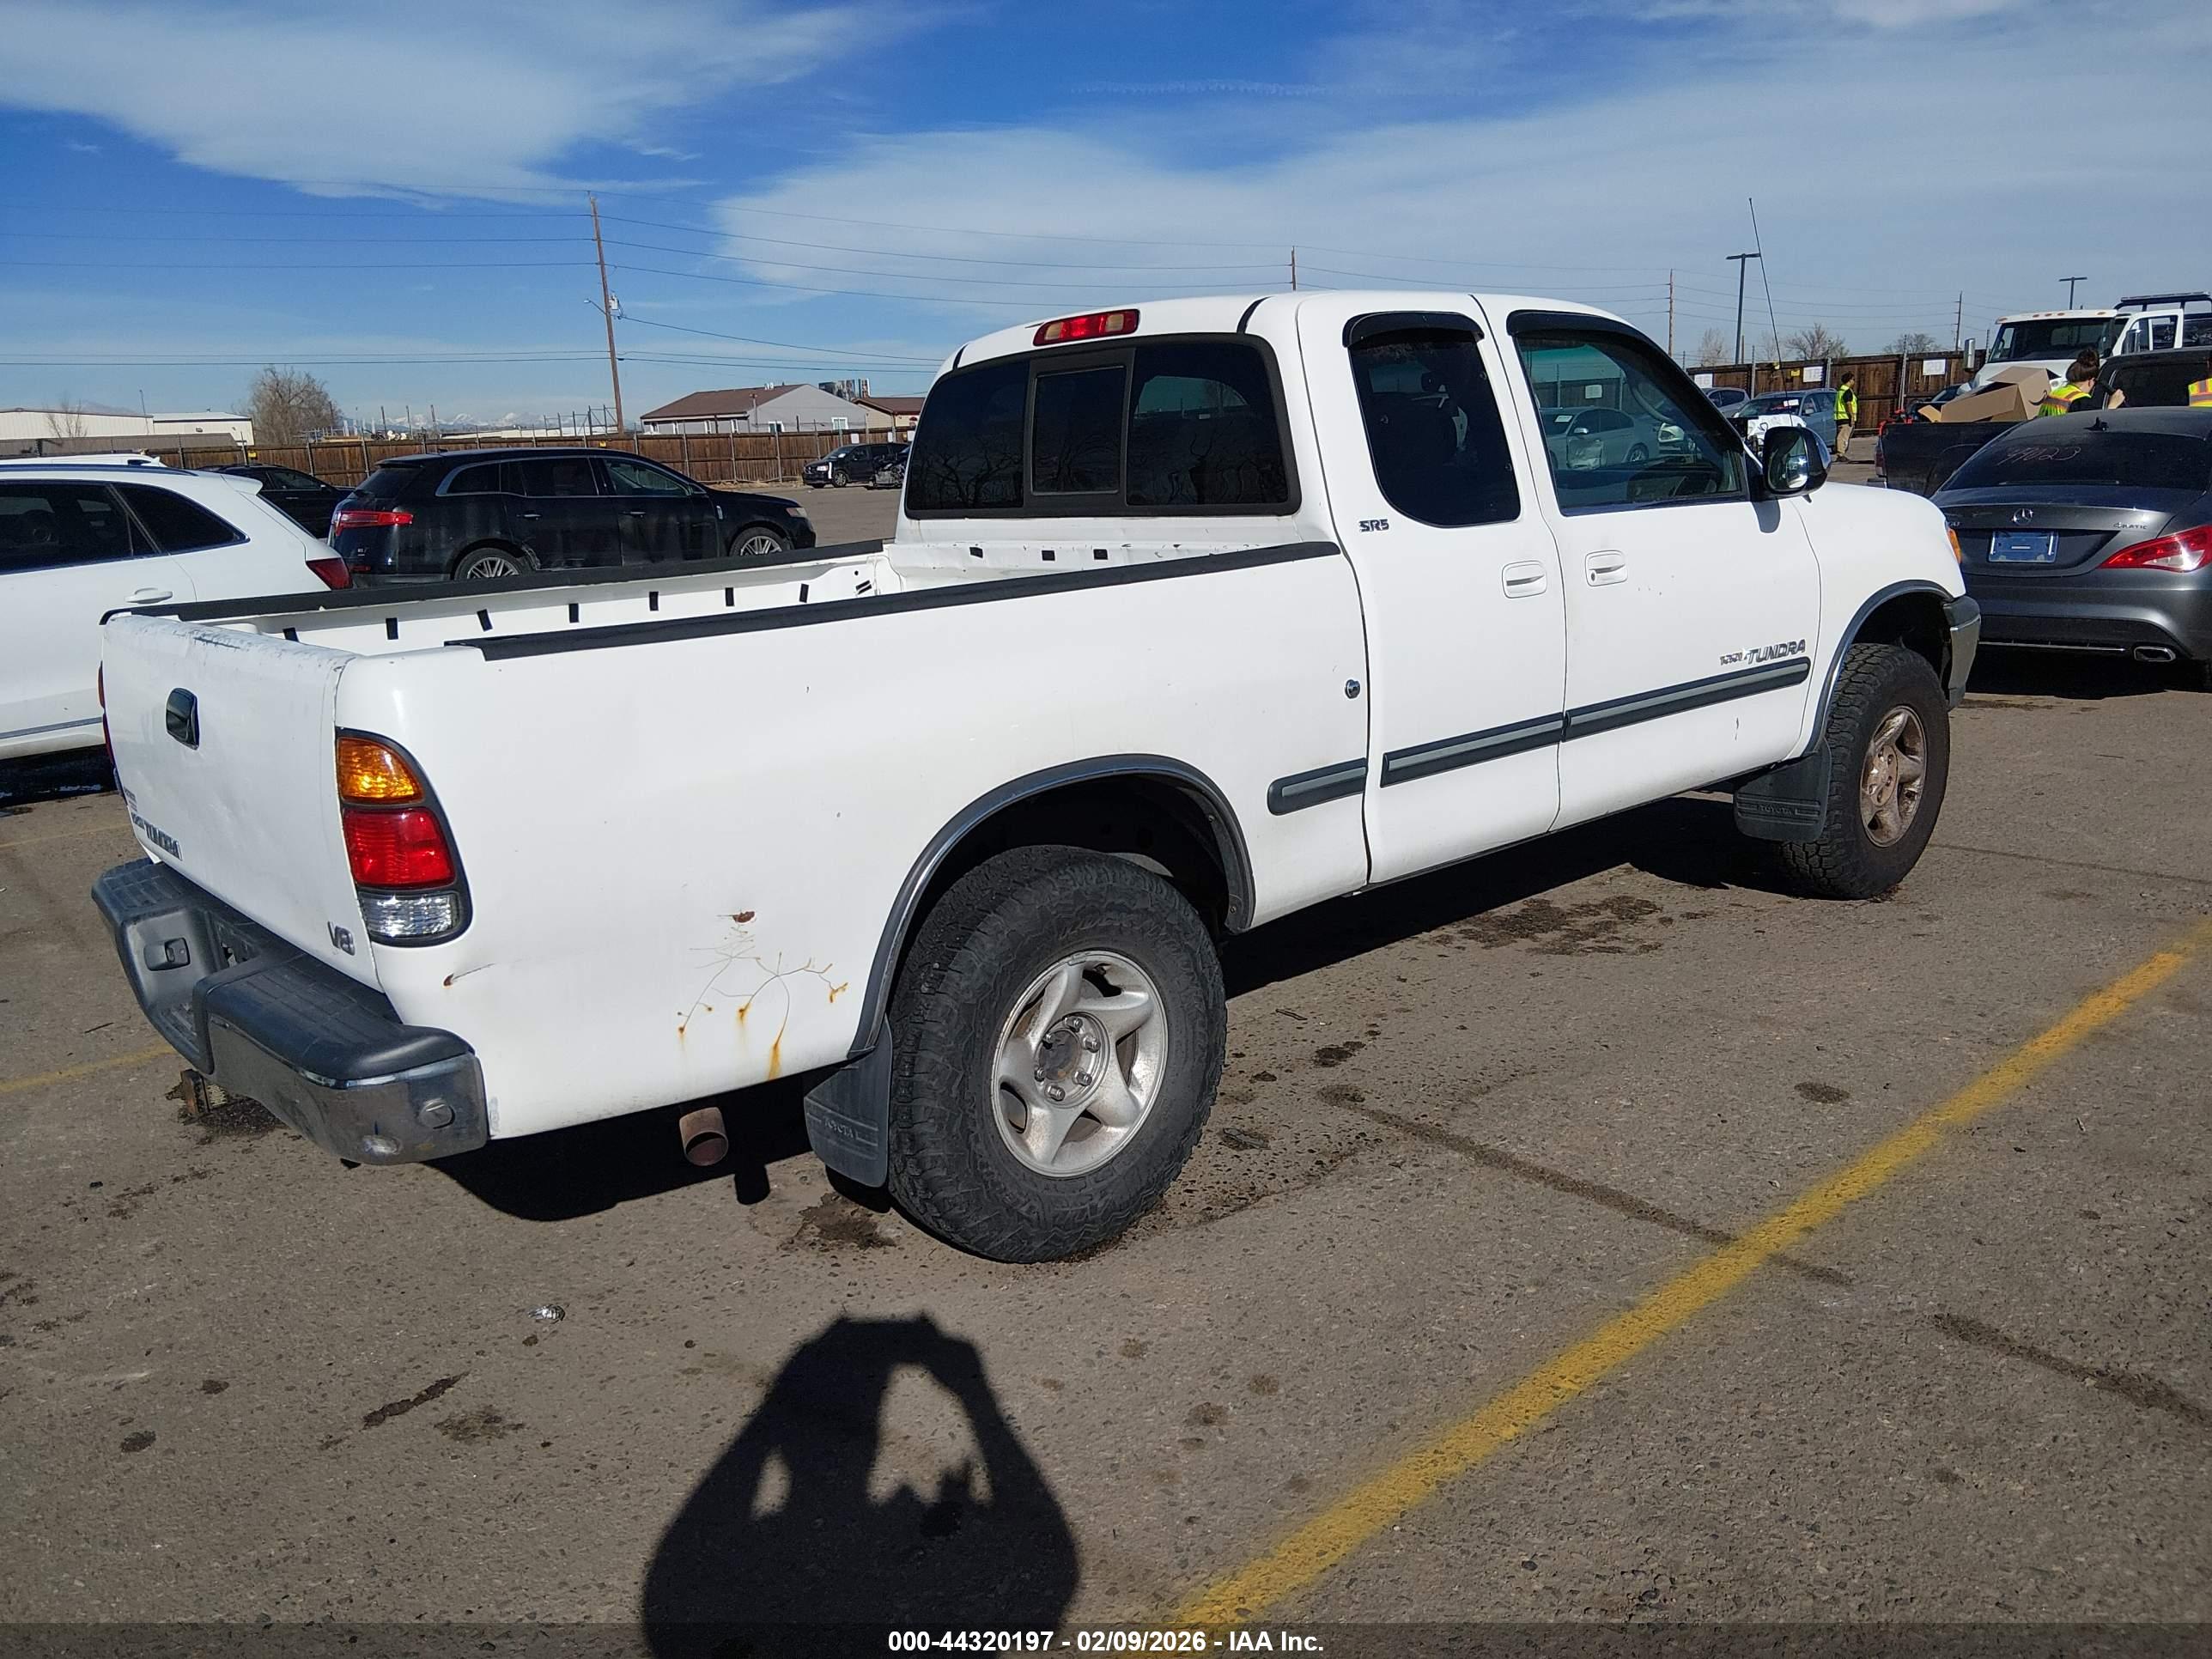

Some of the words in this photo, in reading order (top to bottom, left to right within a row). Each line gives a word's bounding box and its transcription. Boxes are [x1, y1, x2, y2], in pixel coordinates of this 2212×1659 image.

[1358, 519, 1389, 532] SR5
[1744, 639, 1806, 665] TUNDRA
[327, 921, 356, 956] V8
[823, 1116, 854, 1139] TOYOTA
